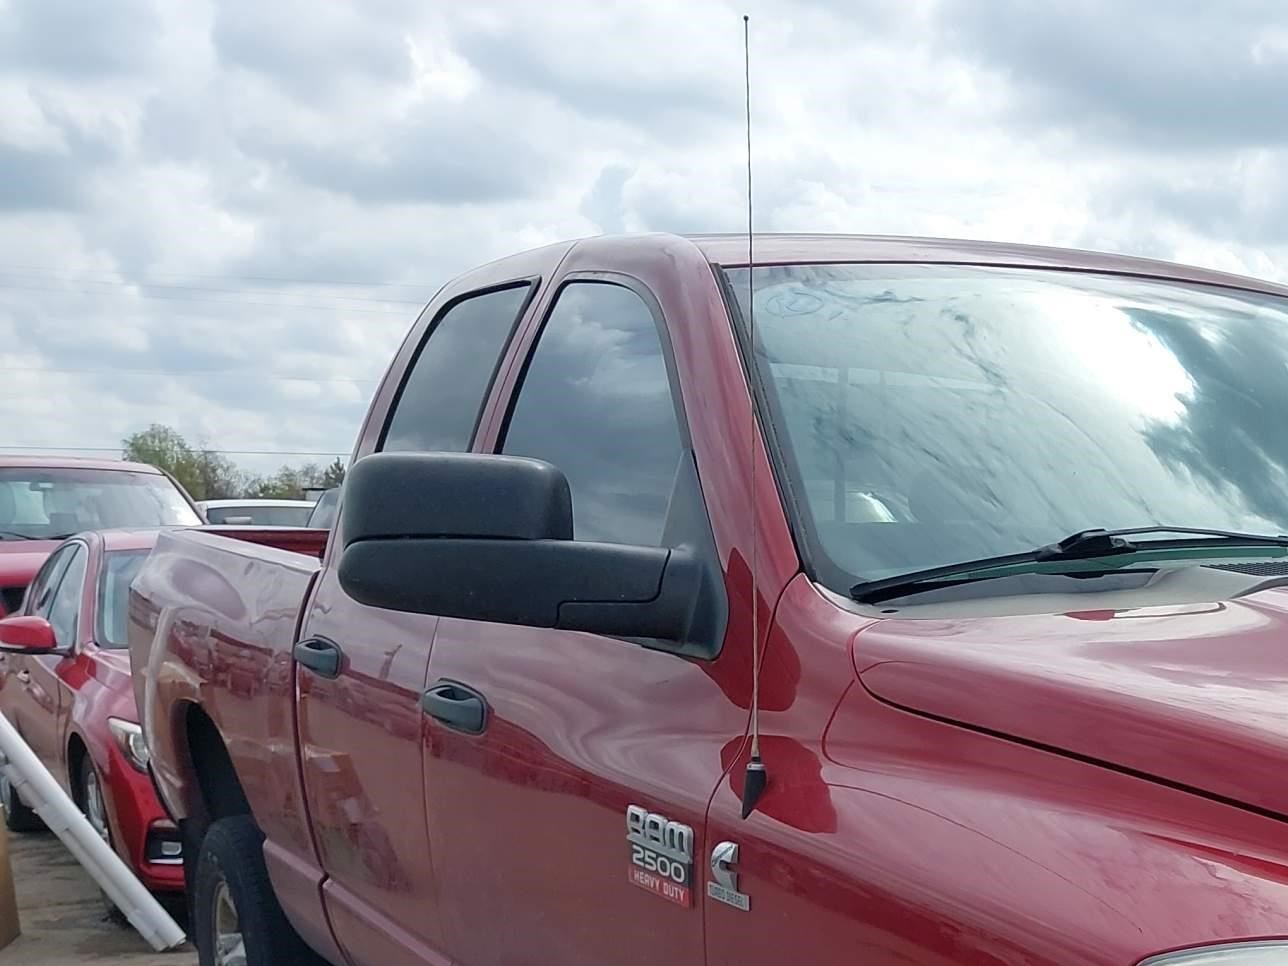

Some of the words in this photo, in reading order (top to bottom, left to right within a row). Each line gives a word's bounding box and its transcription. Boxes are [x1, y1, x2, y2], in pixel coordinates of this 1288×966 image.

[632, 844, 685, 884] 2500
[633, 869, 660, 891] HEAVY
[663, 884, 685, 902] DUTY
